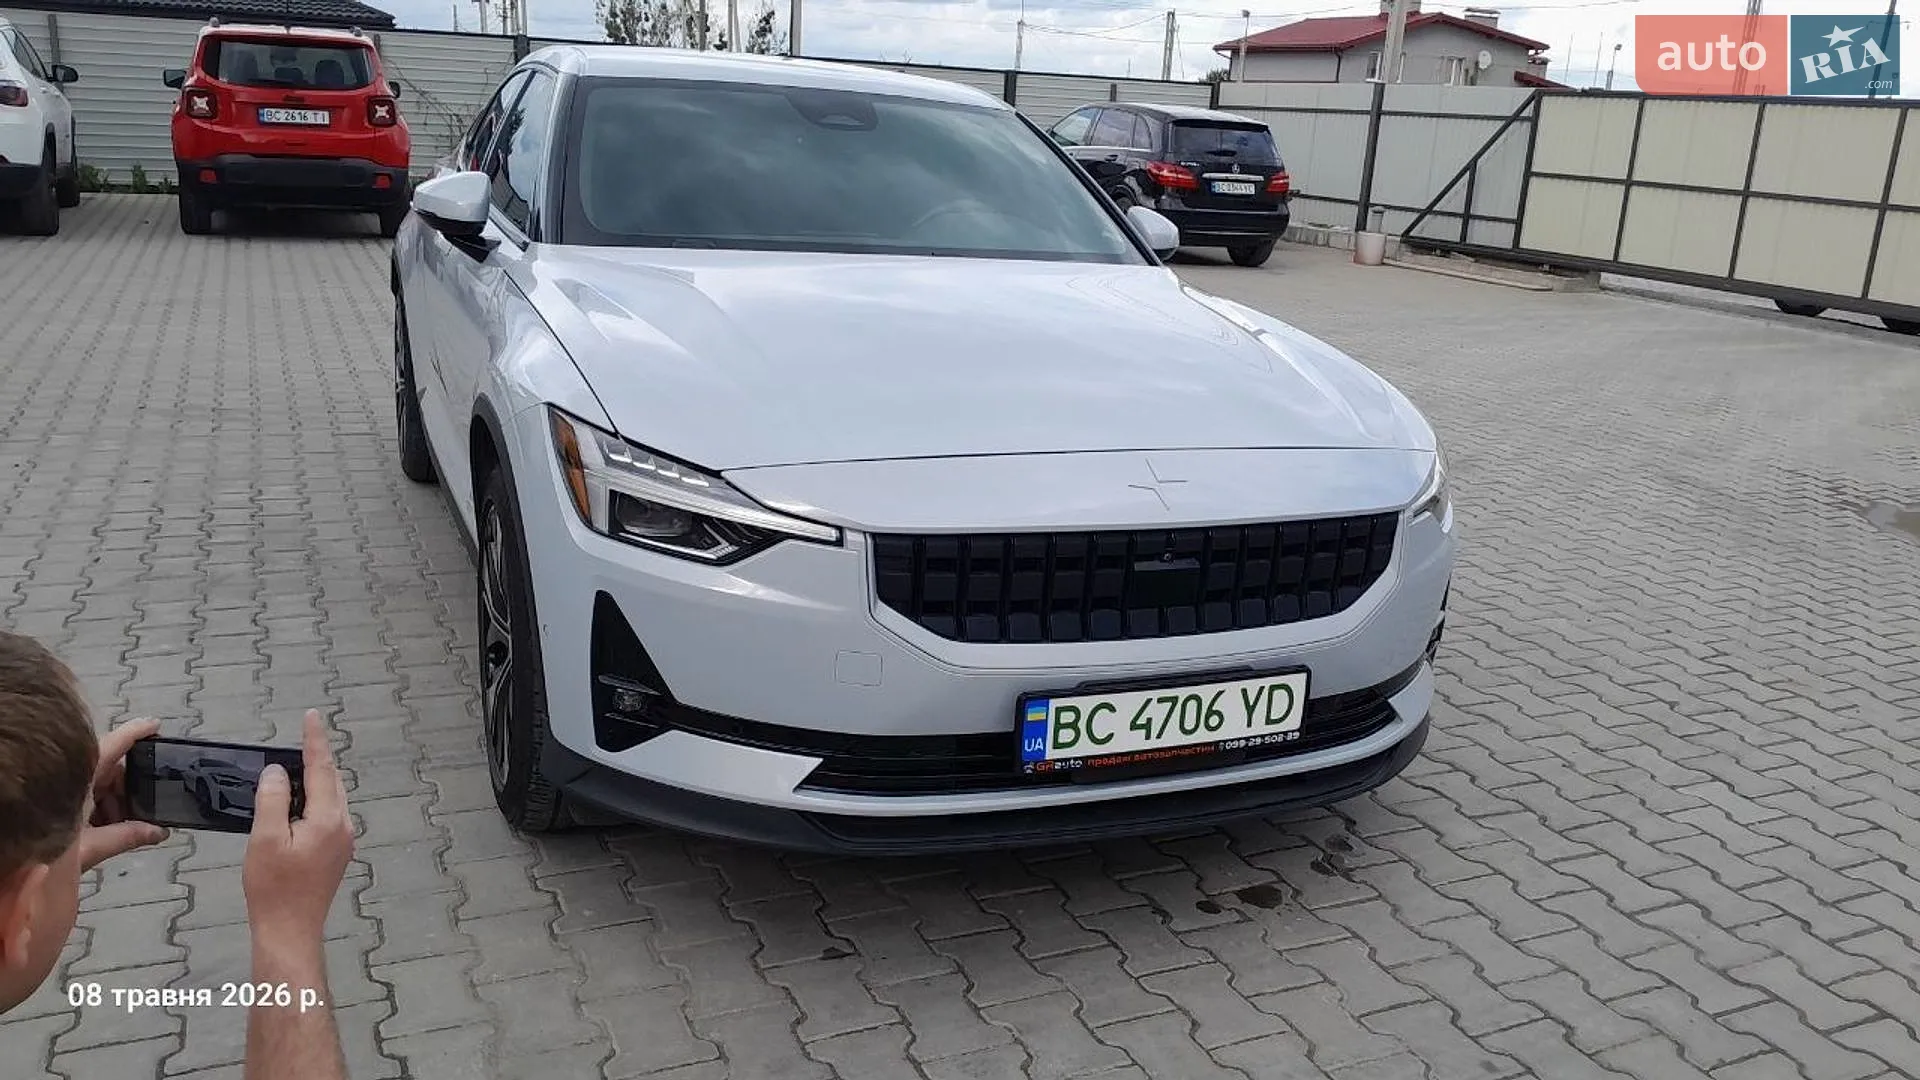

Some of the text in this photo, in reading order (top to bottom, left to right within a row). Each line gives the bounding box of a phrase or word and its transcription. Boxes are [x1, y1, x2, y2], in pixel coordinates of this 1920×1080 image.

[266, 109, 282, 121] BC
[285, 111, 309, 122] 2616
[1052, 682, 1295, 750] BC 4706 YD
[1024, 736, 1044, 752] UA
